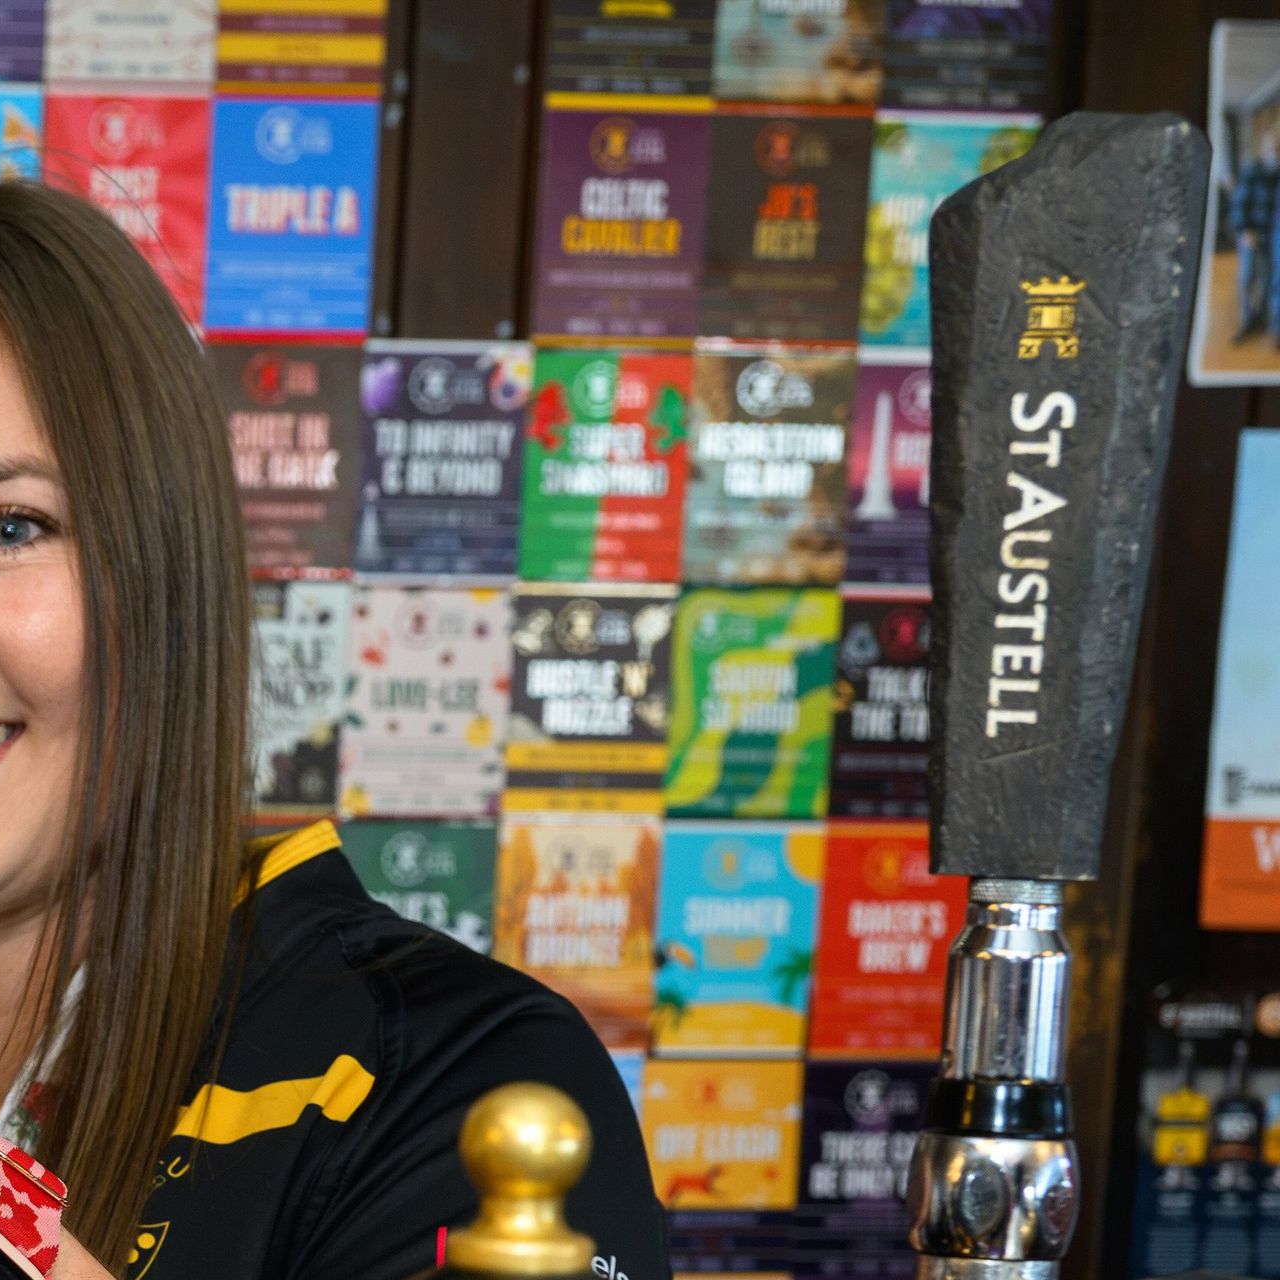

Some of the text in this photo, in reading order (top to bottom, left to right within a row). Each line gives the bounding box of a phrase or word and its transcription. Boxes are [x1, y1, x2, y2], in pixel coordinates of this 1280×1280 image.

[225, 184, 361, 236] TRIPLE A
[373, 417, 516, 459] TO INFINITY
[405, 458, 503, 496] BEYOND
[985, 390, 1077, 740] ST AUSTELL
